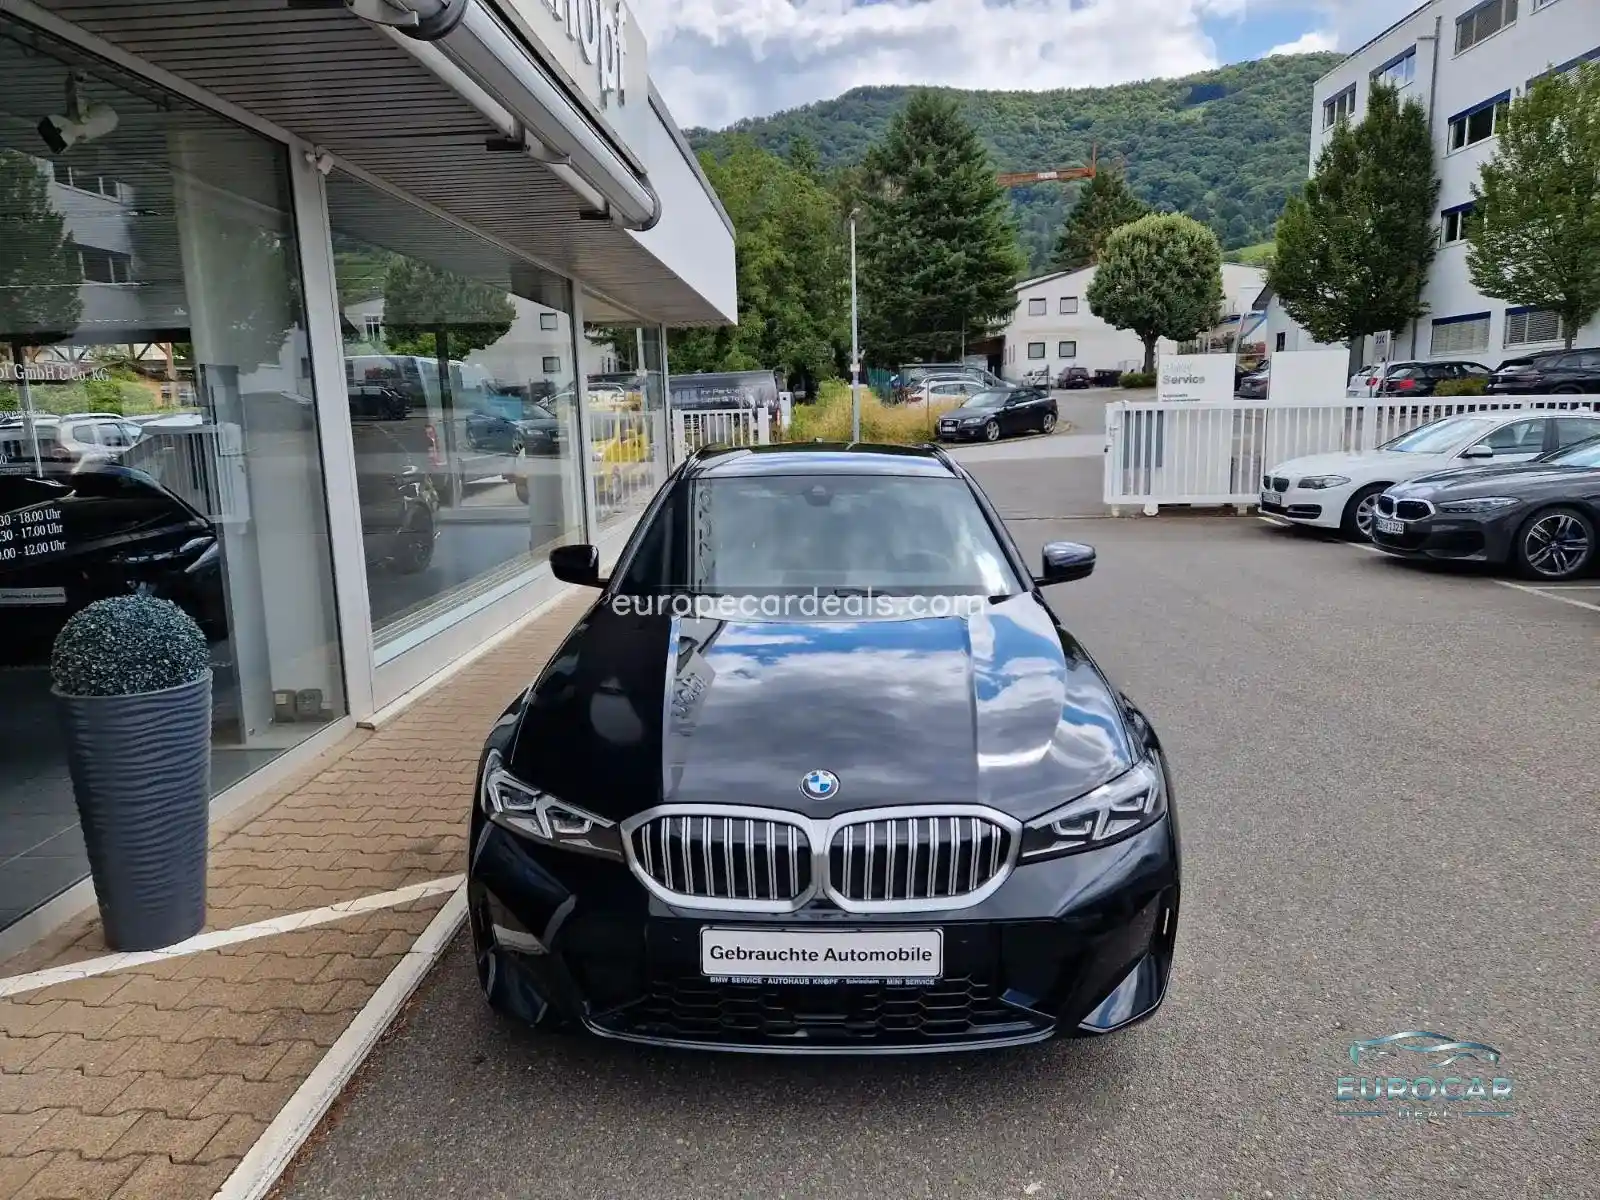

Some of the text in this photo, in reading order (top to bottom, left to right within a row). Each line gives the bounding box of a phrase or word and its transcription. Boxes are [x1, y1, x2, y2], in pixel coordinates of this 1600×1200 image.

[14, 363, 55, 380] GmbH
[1162, 374, 1206, 385] Service
[20, 510, 44, 524] 18.00
[45, 508, 62, 521] Uhr
[21, 525, 46, 539] 17.00
[46, 522, 63, 535] Uhr
[24, 542, 49, 556] 12.00
[50, 540, 67, 552] Uhr
[710, 945, 933, 962] Gebrauchte Automobile
